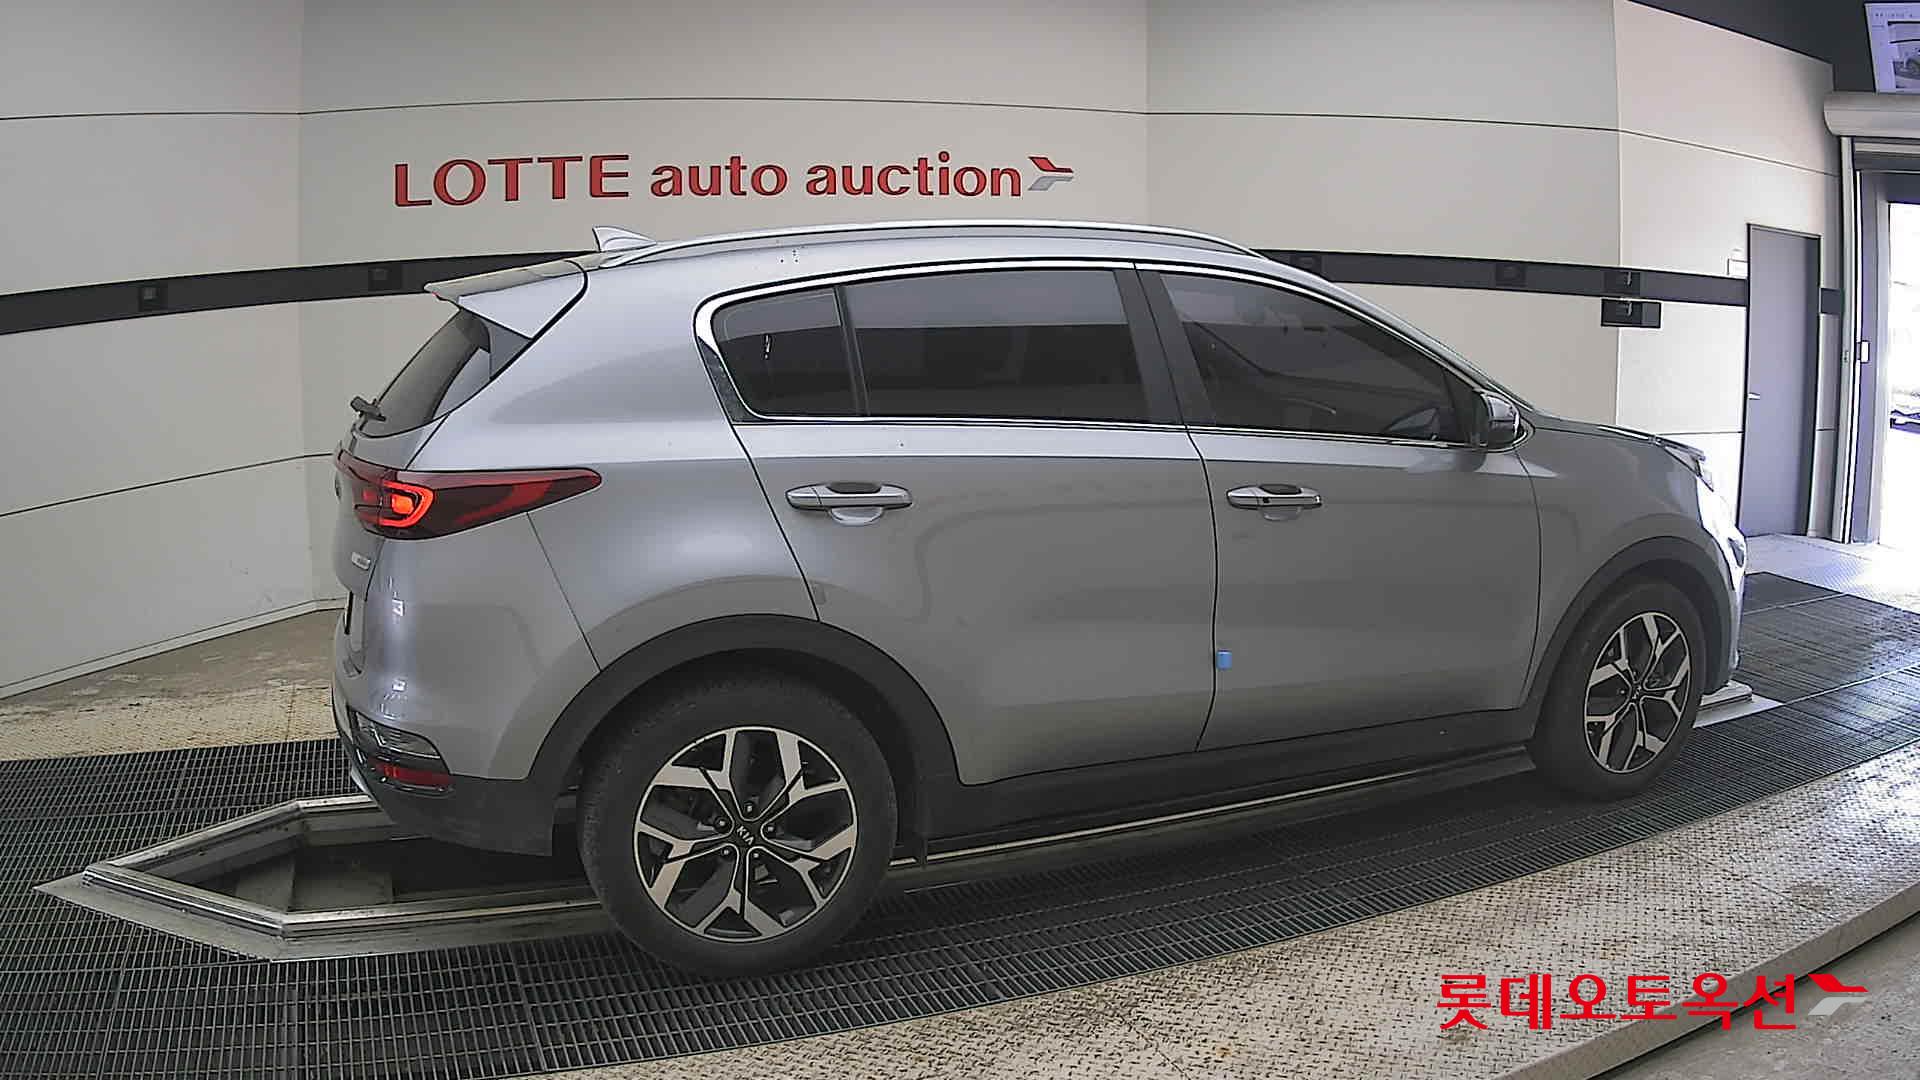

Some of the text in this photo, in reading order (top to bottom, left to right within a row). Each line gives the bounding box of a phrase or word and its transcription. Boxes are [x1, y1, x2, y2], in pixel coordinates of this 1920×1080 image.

[394, 151, 1022, 207] LOTTE auto auction
[737, 825, 755, 846] KIA
